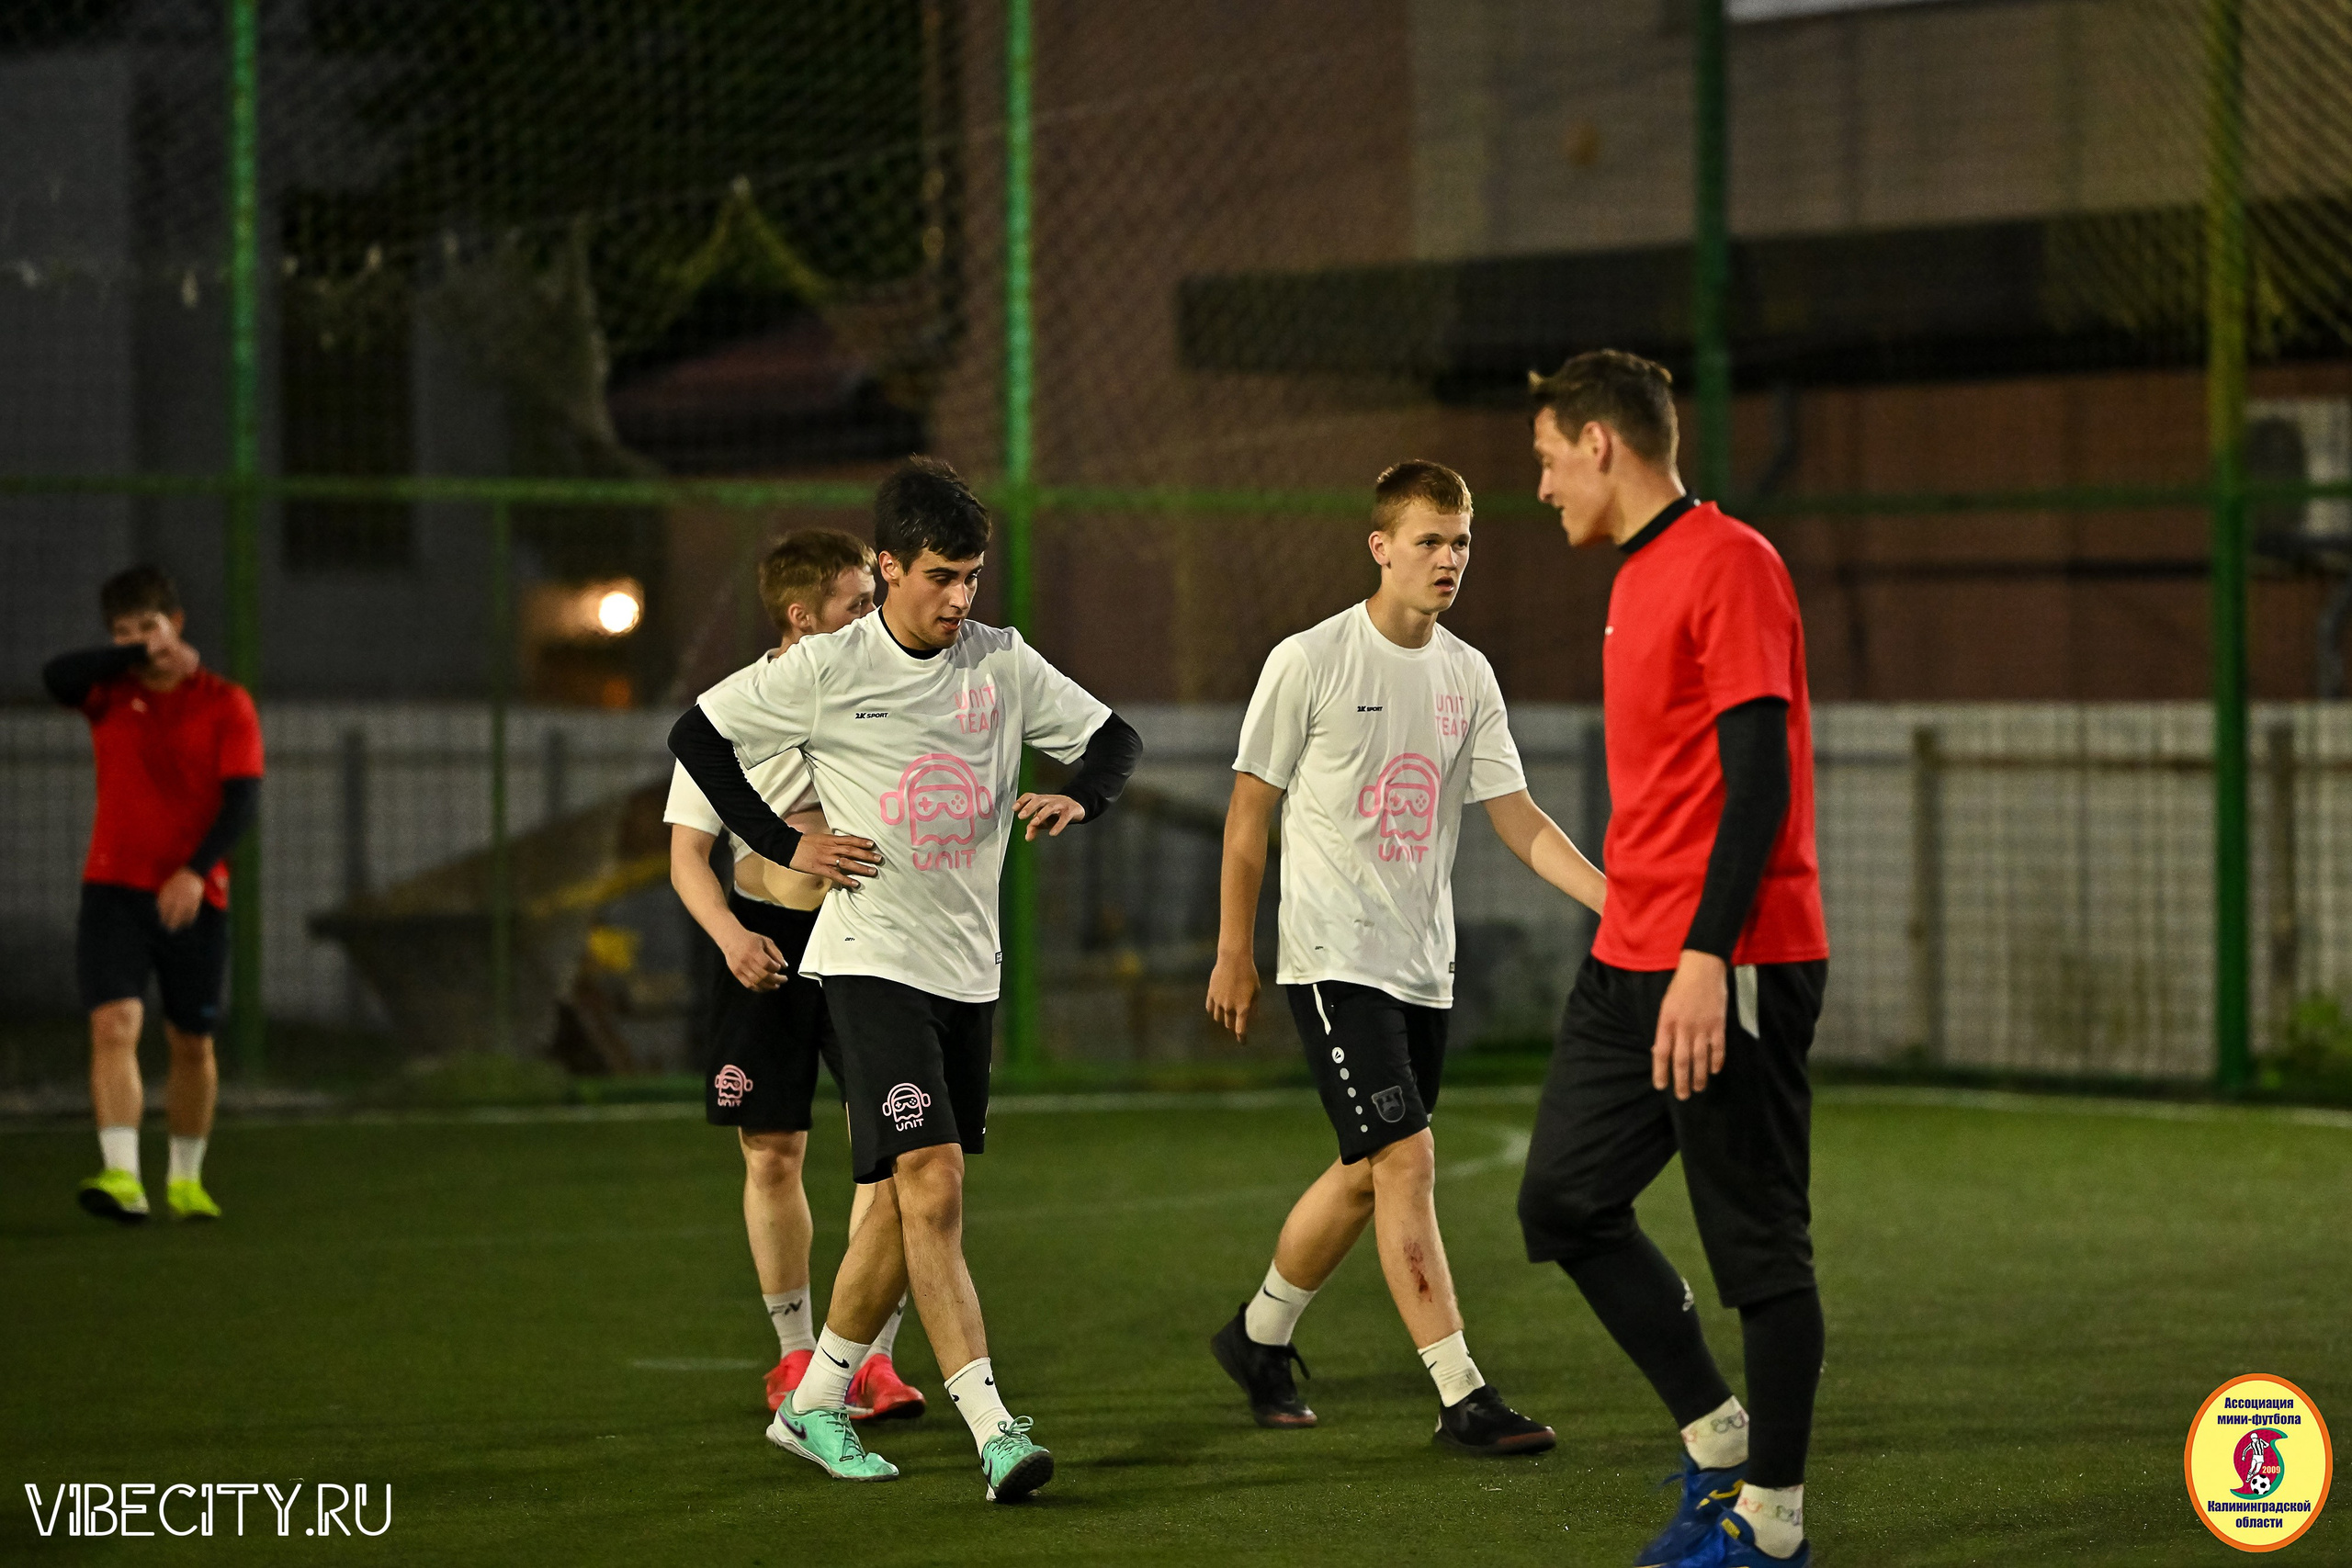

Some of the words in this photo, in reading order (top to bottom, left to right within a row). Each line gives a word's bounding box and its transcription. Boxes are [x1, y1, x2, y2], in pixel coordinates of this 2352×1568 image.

[955, 685, 995, 710] UNIT
[912, 849, 977, 871] UNIT
[896, 1118, 924, 1132] UNIT
